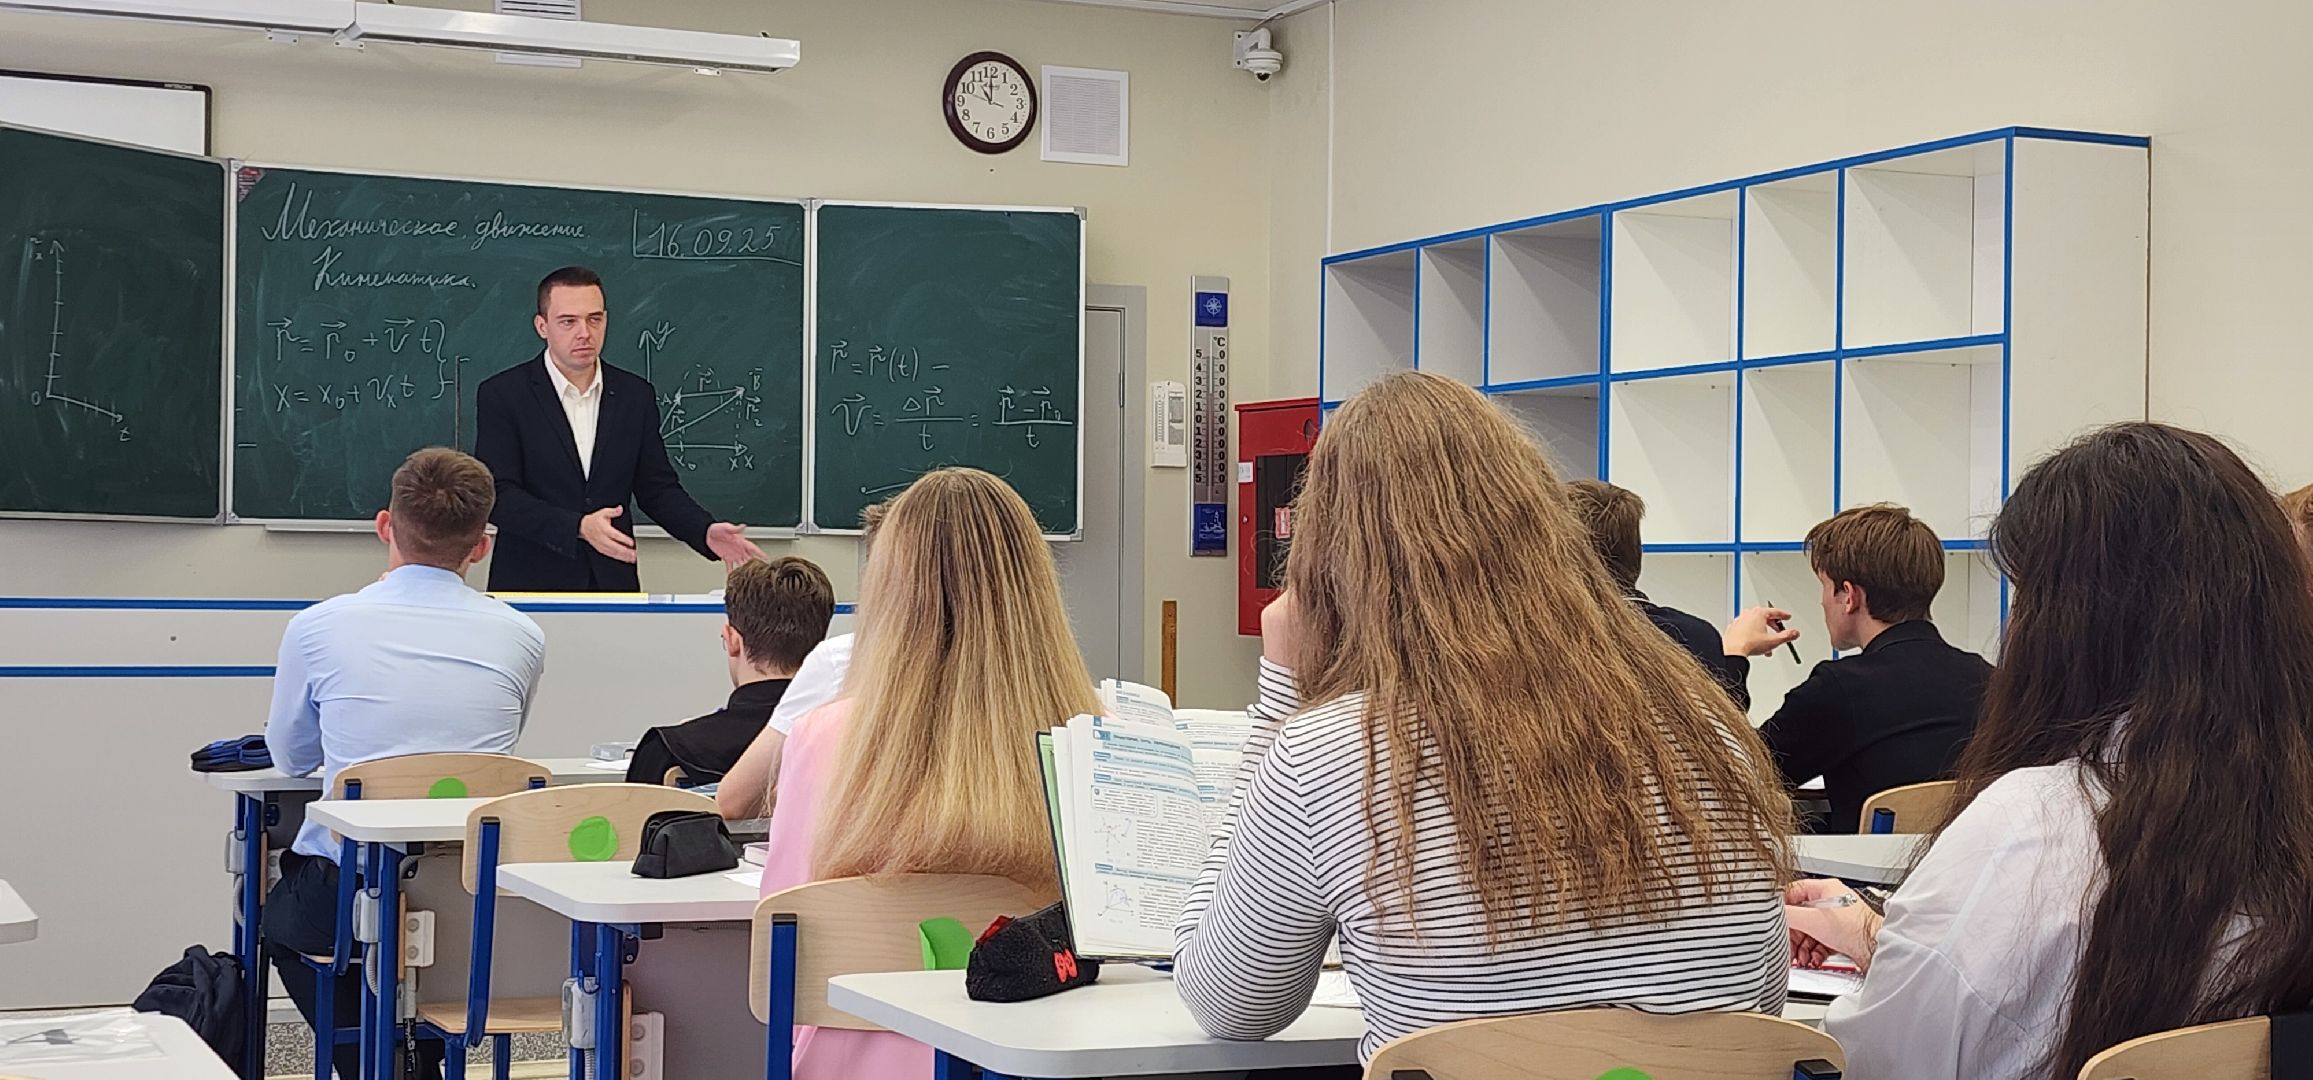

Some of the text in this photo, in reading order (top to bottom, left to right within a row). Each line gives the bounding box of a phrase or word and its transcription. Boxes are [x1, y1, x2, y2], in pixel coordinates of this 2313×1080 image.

[971, 71, 983, 82] 11
[984, 66, 998, 78] 12
[1002, 72, 1009, 84] 1
[961, 82, 975, 94] 10
[1010, 84, 1018, 95] 2
[957, 95, 965, 107] 9
[1016, 98, 1024, 110] 3
[962, 109, 970, 121] 8
[1010, 112, 1018, 123] 4
[973, 122, 981, 134] 7
[987, 127, 995, 139] 6
[1002, 123, 1010, 134] 5
[1213, 336, 1225, 347] °C
[1196, 349, 1225, 359] 5 0
[1196, 363, 1225, 372] 4 0
[1196, 376, 1225, 386] 3 0
[1196, 390, 1225, 398] 2 0
[1196, 402, 1225, 411] 1 0
[1196, 415, 1225, 424] 0 0
[1196, 427, 1225, 436] 1 0
[1196, 439, 1225, 448] 2 0
[1196, 450, 1225, 460] 3 0
[1196, 462, 1225, 471] 4 0
[1196, 474, 1225, 483] 5 0
